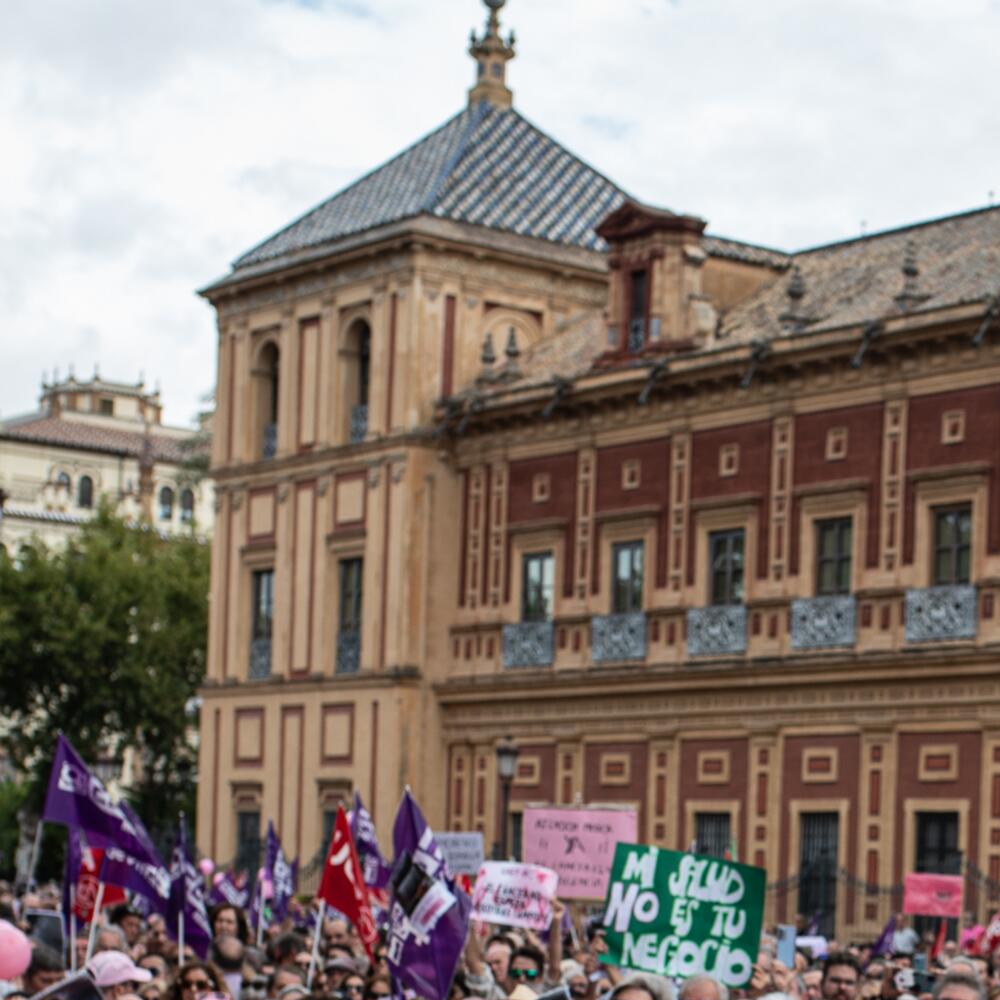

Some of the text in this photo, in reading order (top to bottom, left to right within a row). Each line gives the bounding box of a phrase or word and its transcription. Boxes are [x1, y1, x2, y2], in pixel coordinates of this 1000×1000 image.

[668, 854, 745, 904] SALUD
[603, 881, 746, 940] NO ES TU
[620, 931, 752, 986] NEGOCIO
